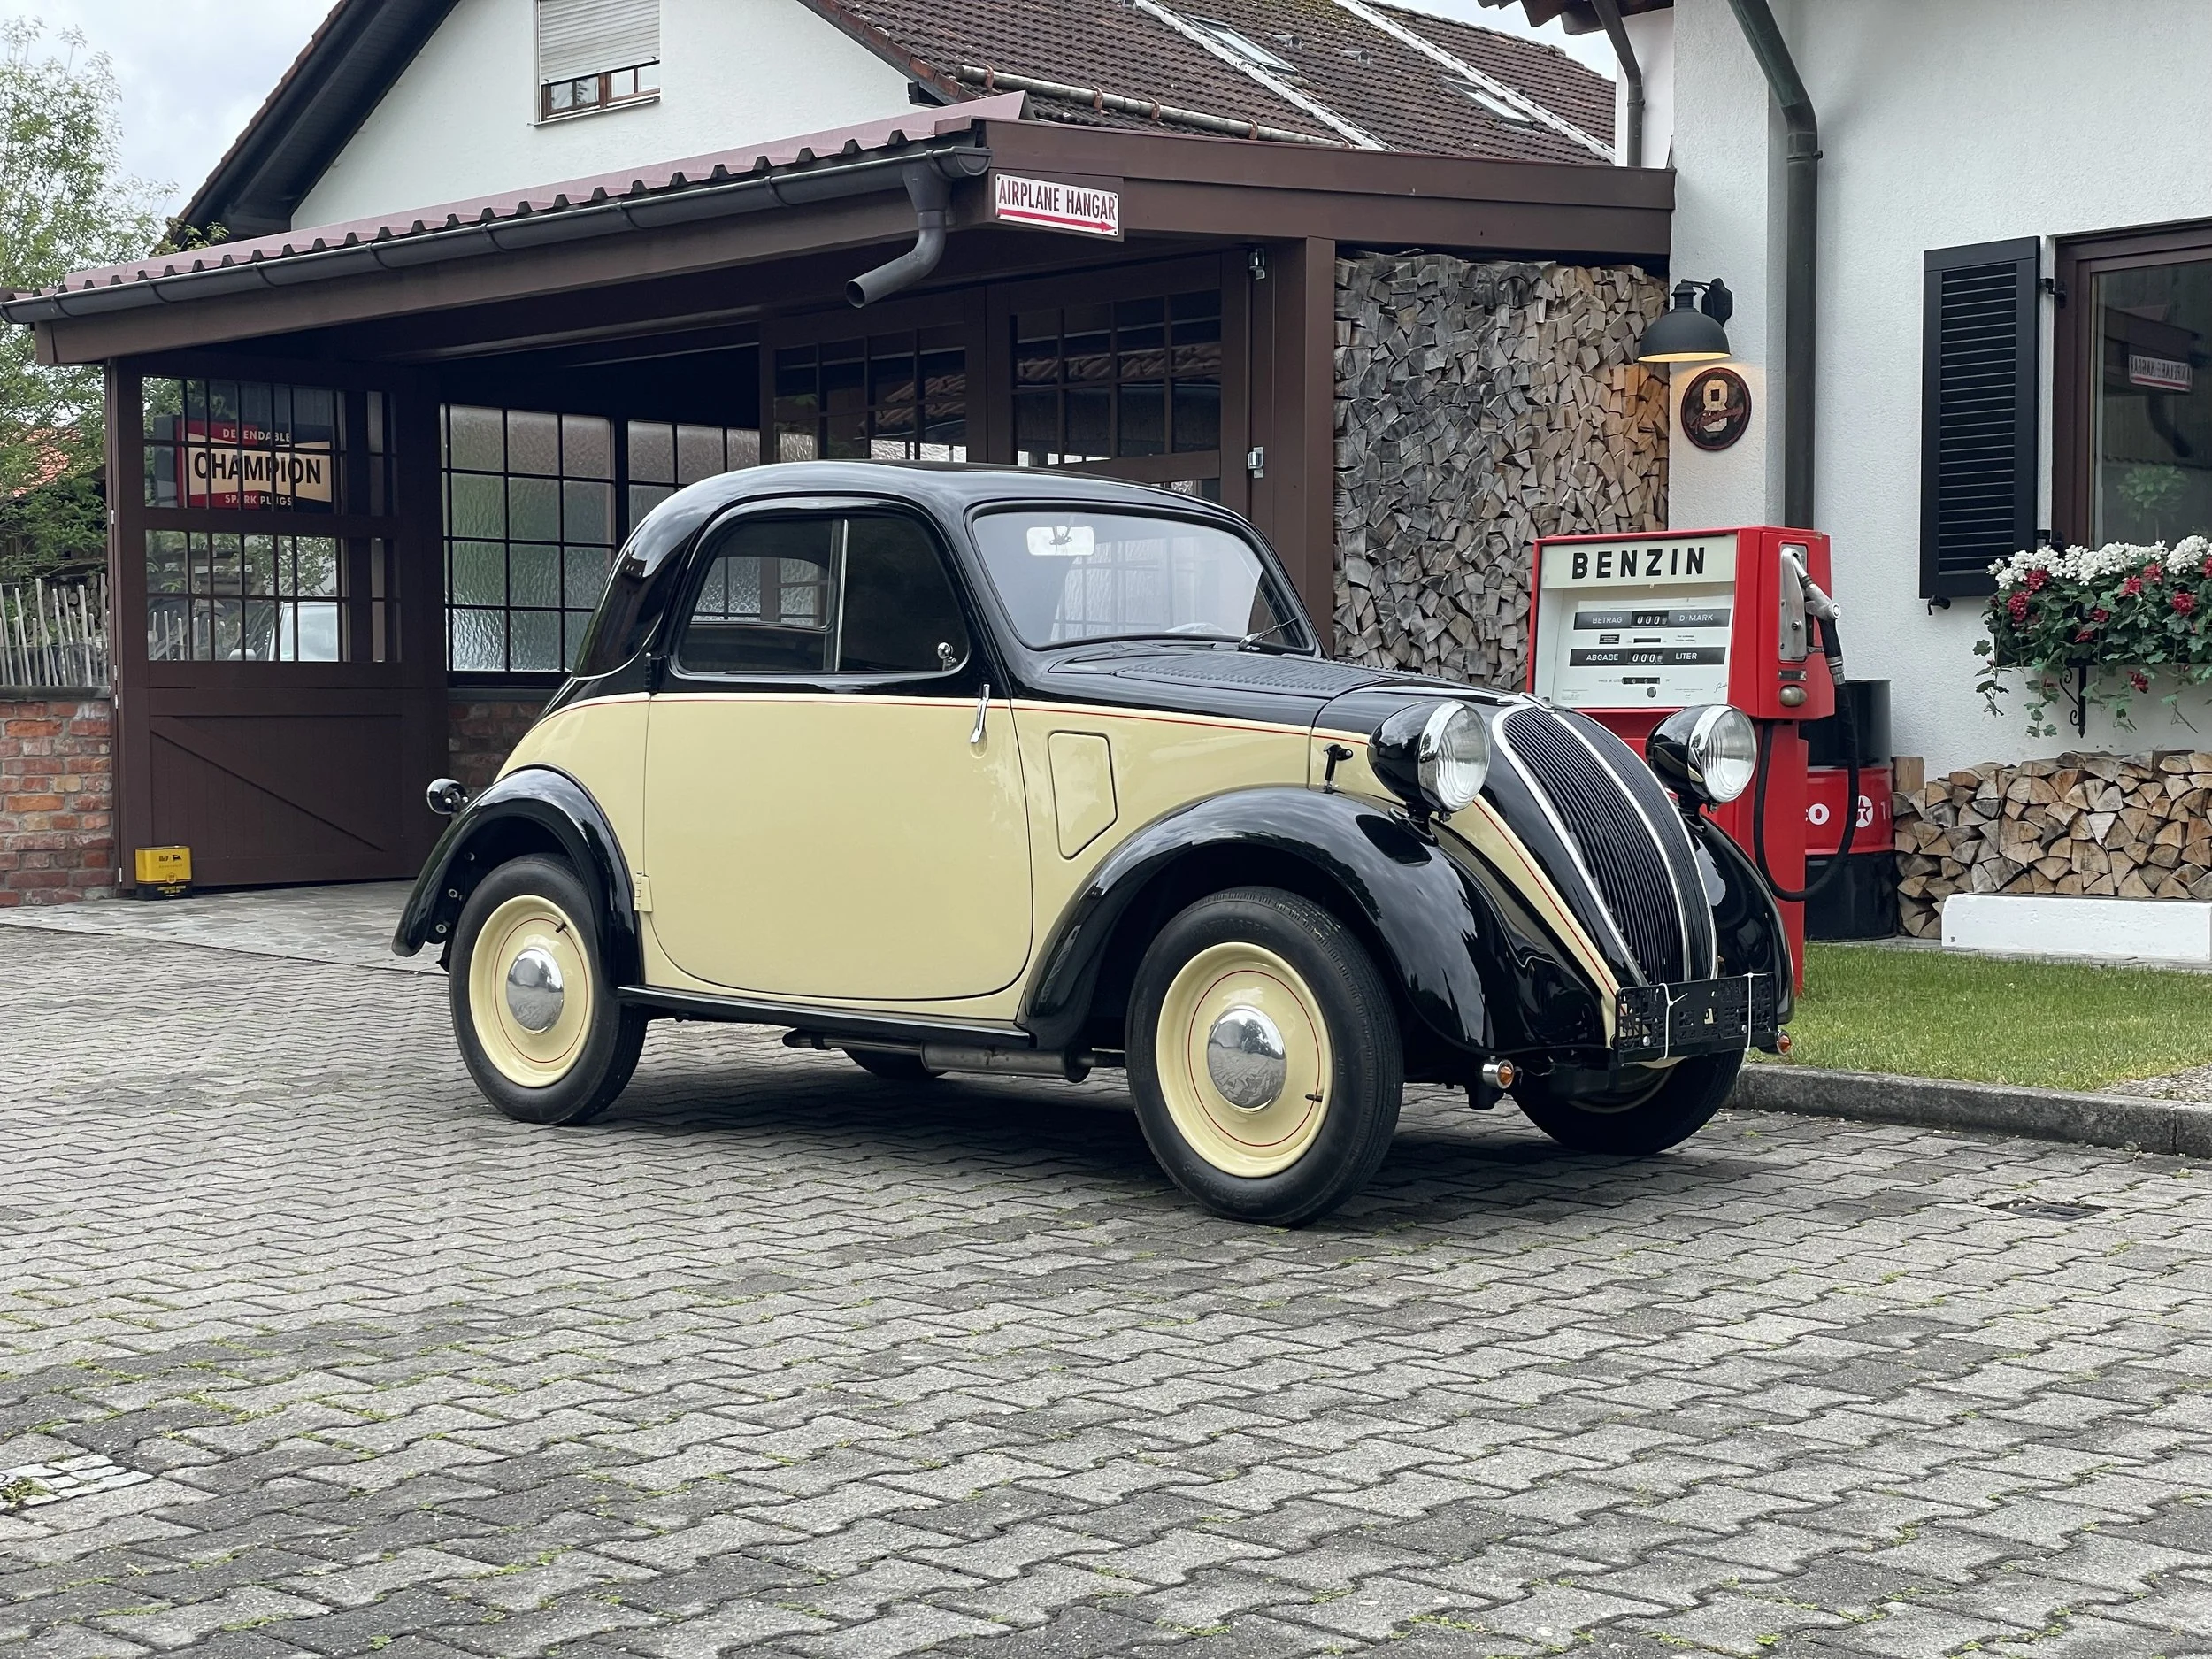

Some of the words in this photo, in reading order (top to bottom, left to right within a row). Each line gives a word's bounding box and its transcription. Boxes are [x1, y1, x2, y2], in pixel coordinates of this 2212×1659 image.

[998, 179, 1060, 212] AIRPLANE
[1066, 189, 1117, 221] HANGAR
[222, 428, 291, 442] DEENDABLE
[194, 451, 321, 485] CHAMPION
[224, 494, 257, 505] SPRK
[1571, 547, 1705, 580] BENZIN
[1592, 616, 1623, 625] BETRAG
[1586, 653, 1619, 662] ABGABE
[1675, 652, 1698, 661] LITER
